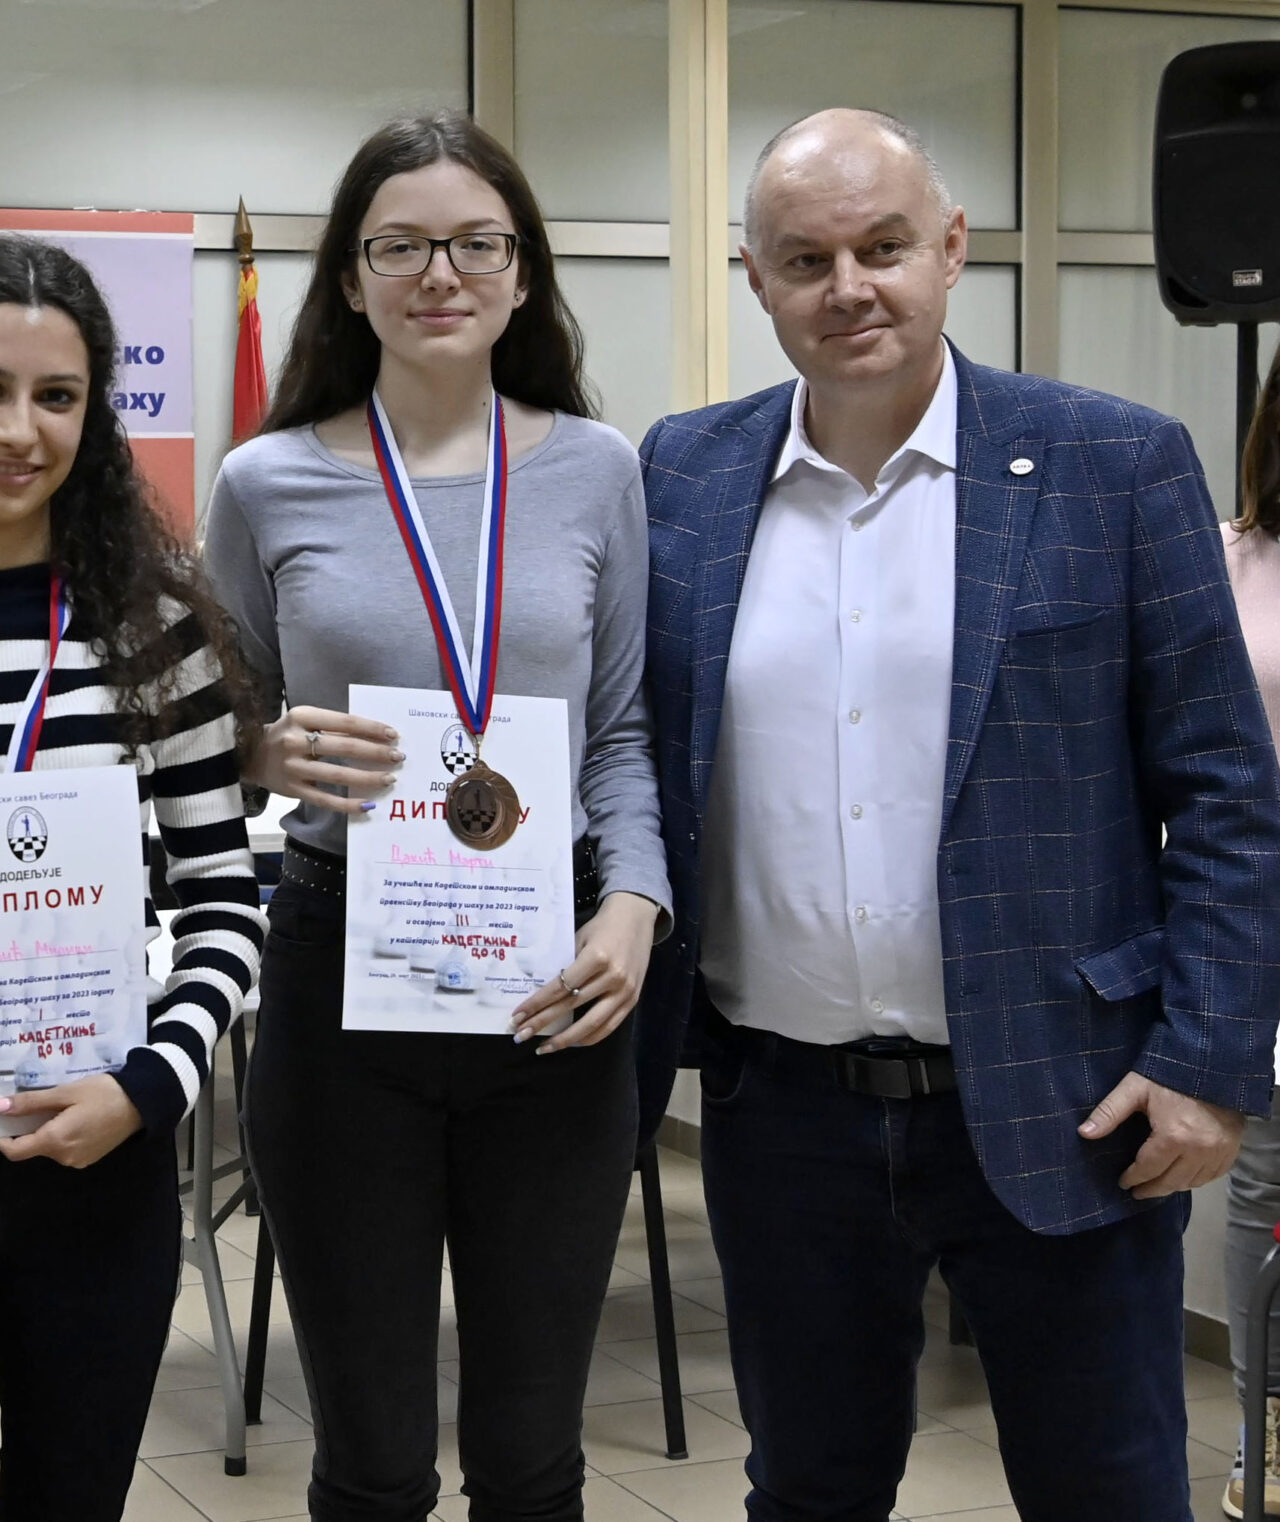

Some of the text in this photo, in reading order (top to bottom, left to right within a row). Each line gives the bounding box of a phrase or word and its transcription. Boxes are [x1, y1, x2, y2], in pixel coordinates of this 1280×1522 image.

[111, 392, 166, 418] аху
[389, 799, 530, 824] ДИПУ
[0, 867, 62, 884] ДОДЕЉУЈЕ
[495, 902, 513, 911] 2023
[491, 949, 506, 961] 18
[72, 990, 90, 999] 2023
[58, 1042, 73, 1056] 18
